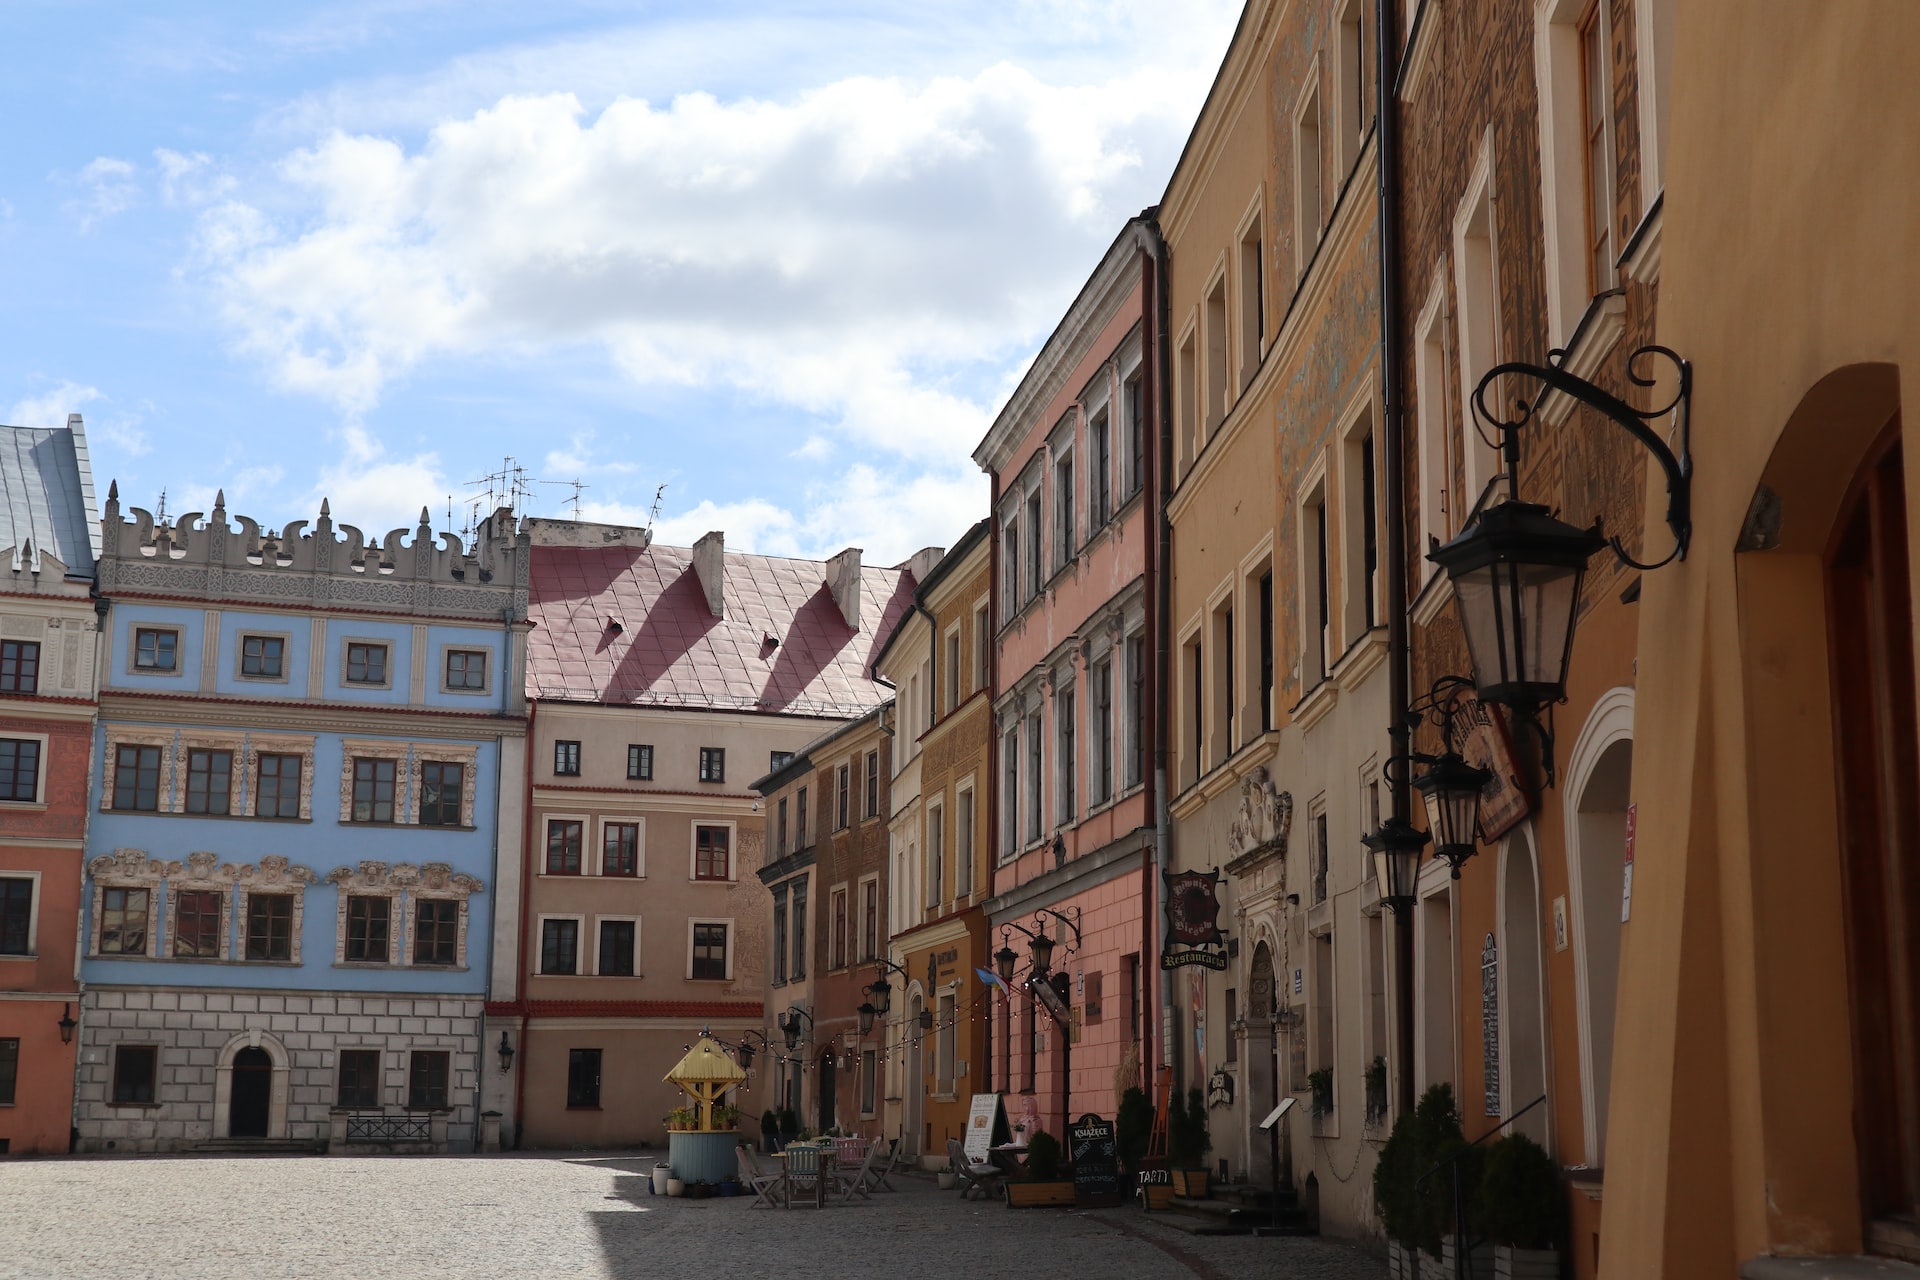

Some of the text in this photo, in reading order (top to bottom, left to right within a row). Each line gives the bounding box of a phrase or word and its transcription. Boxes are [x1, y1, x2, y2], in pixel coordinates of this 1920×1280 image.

[1165, 953, 1225, 967] Restauracja
[1074, 1126, 1109, 1138] KSIĄŻĘCE
[1138, 1169, 1169, 1184] TARTY
